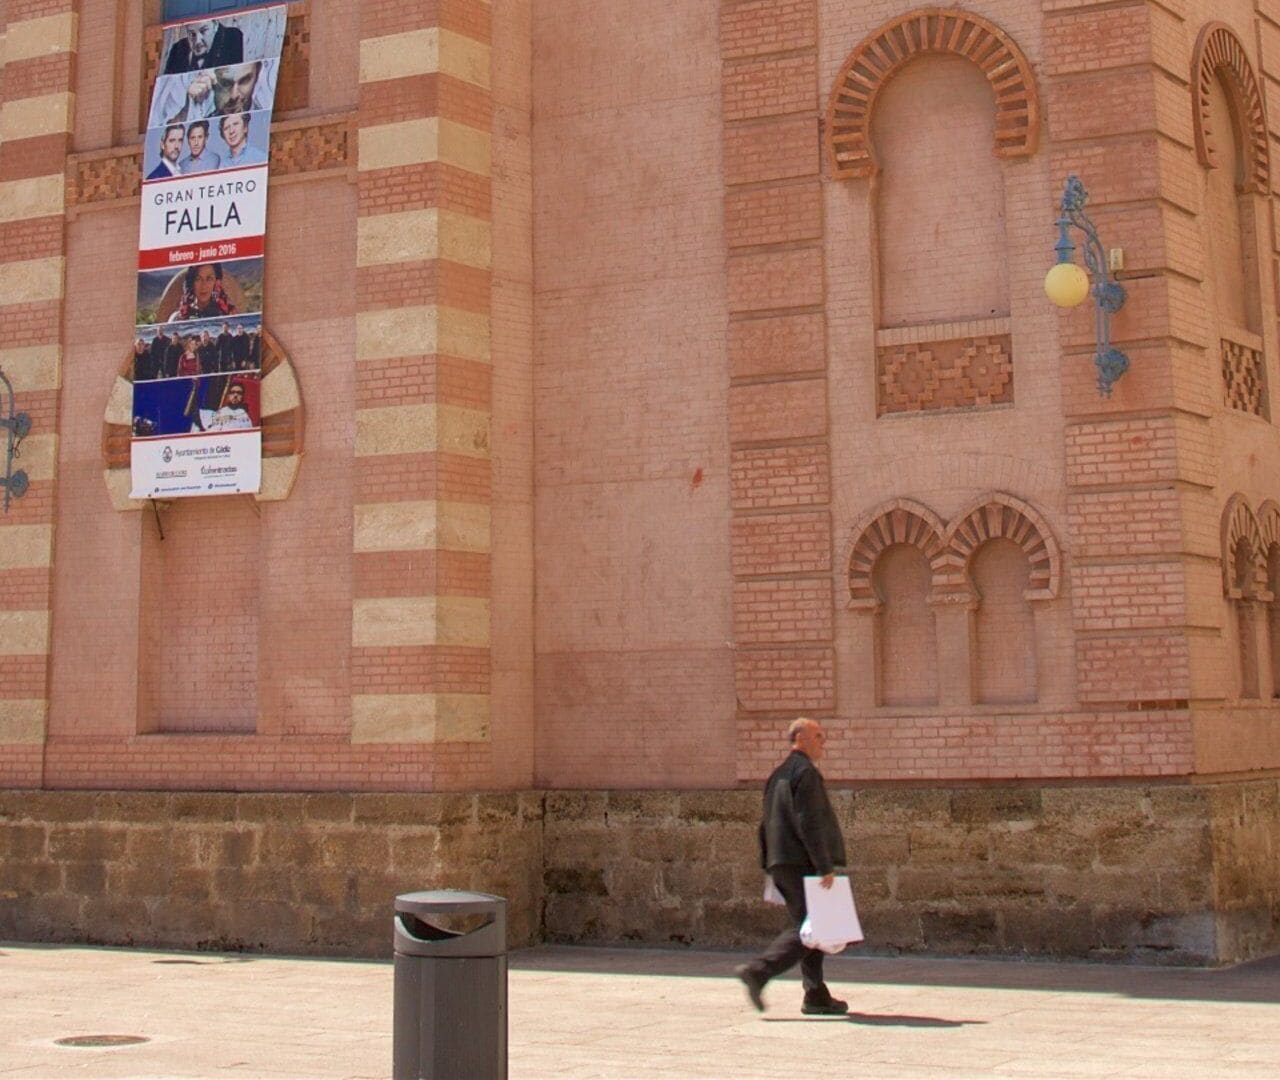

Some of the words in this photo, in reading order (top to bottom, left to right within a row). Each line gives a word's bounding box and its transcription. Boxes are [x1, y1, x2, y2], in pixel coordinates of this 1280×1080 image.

[155, 189, 194, 206] GRAN
[199, 180, 257, 199] TEATRO
[165, 201, 242, 235] FALLA
[199, 246, 218, 261] junio
